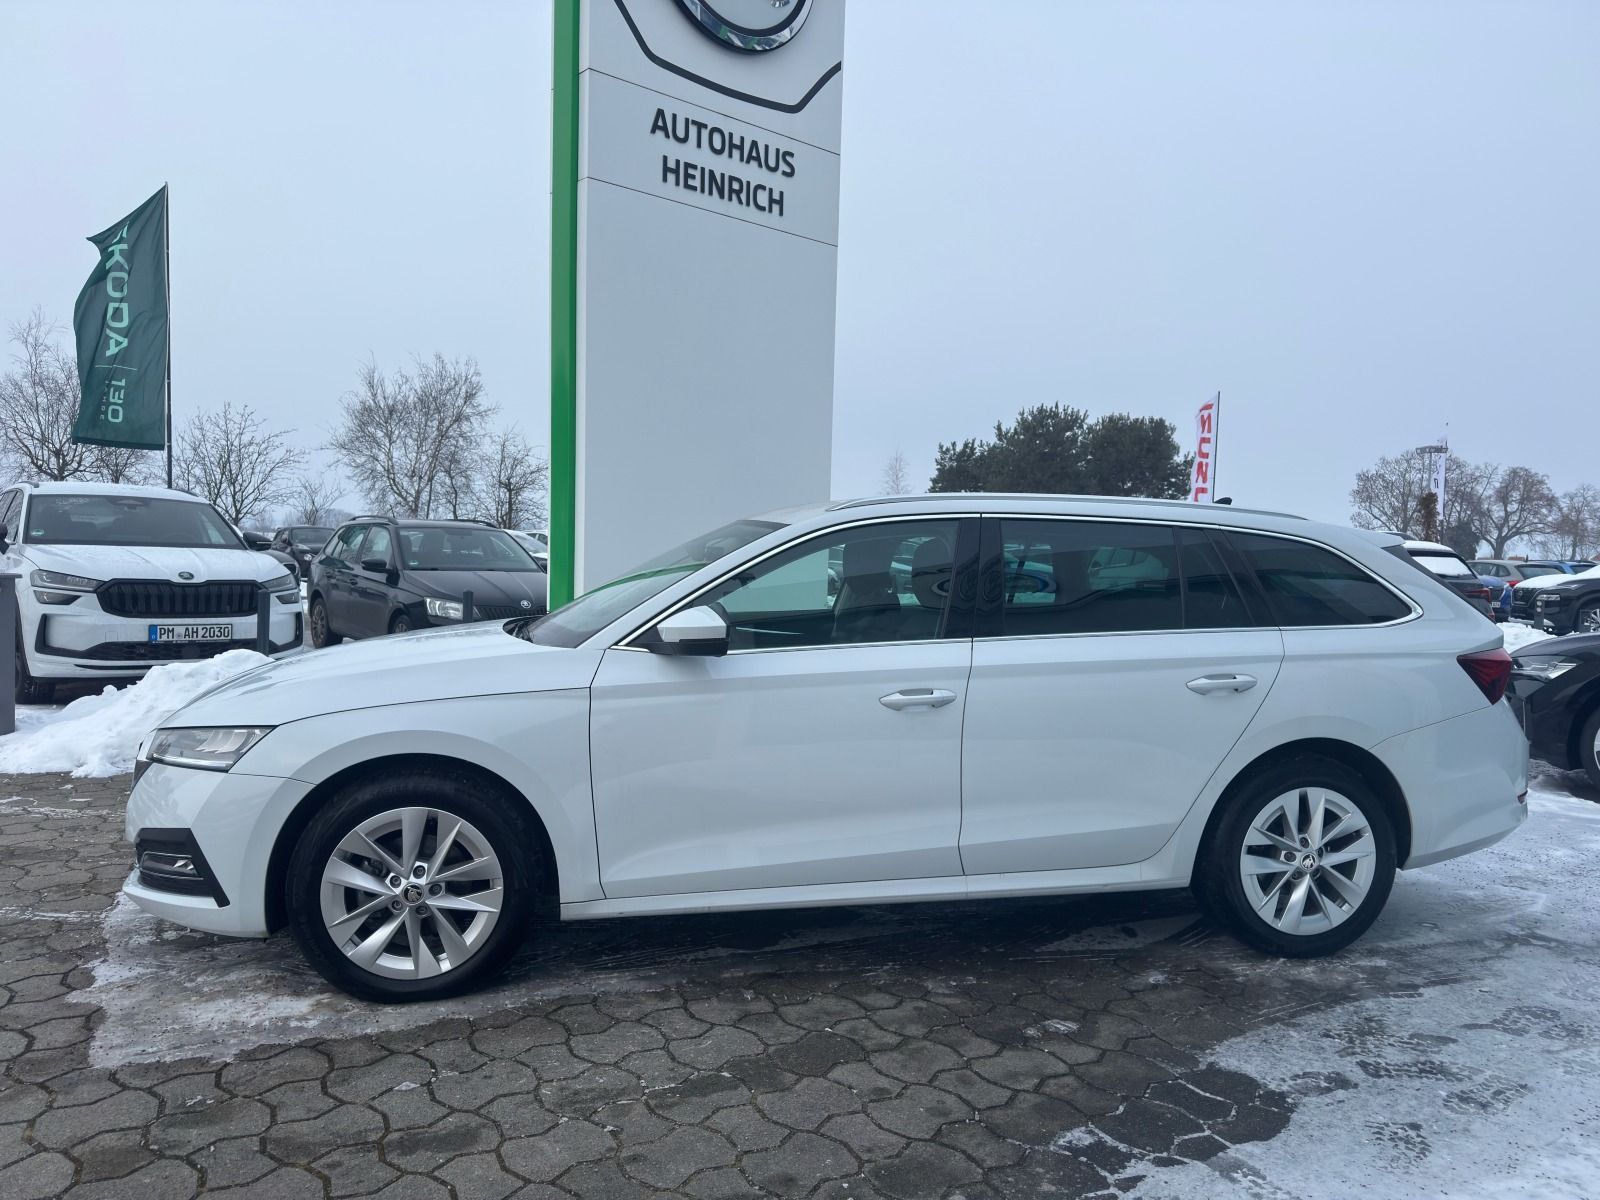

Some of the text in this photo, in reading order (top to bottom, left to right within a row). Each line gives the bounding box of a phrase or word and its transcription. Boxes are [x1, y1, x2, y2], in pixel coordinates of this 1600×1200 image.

[650, 107, 796, 178] AUTOHAUS
[662, 154, 784, 217] HEINRICH
[107, 378, 126, 423] 130
[159, 627, 175, 639] PM
[183, 626, 199, 639] AH
[201, 626, 230, 639] 2030
